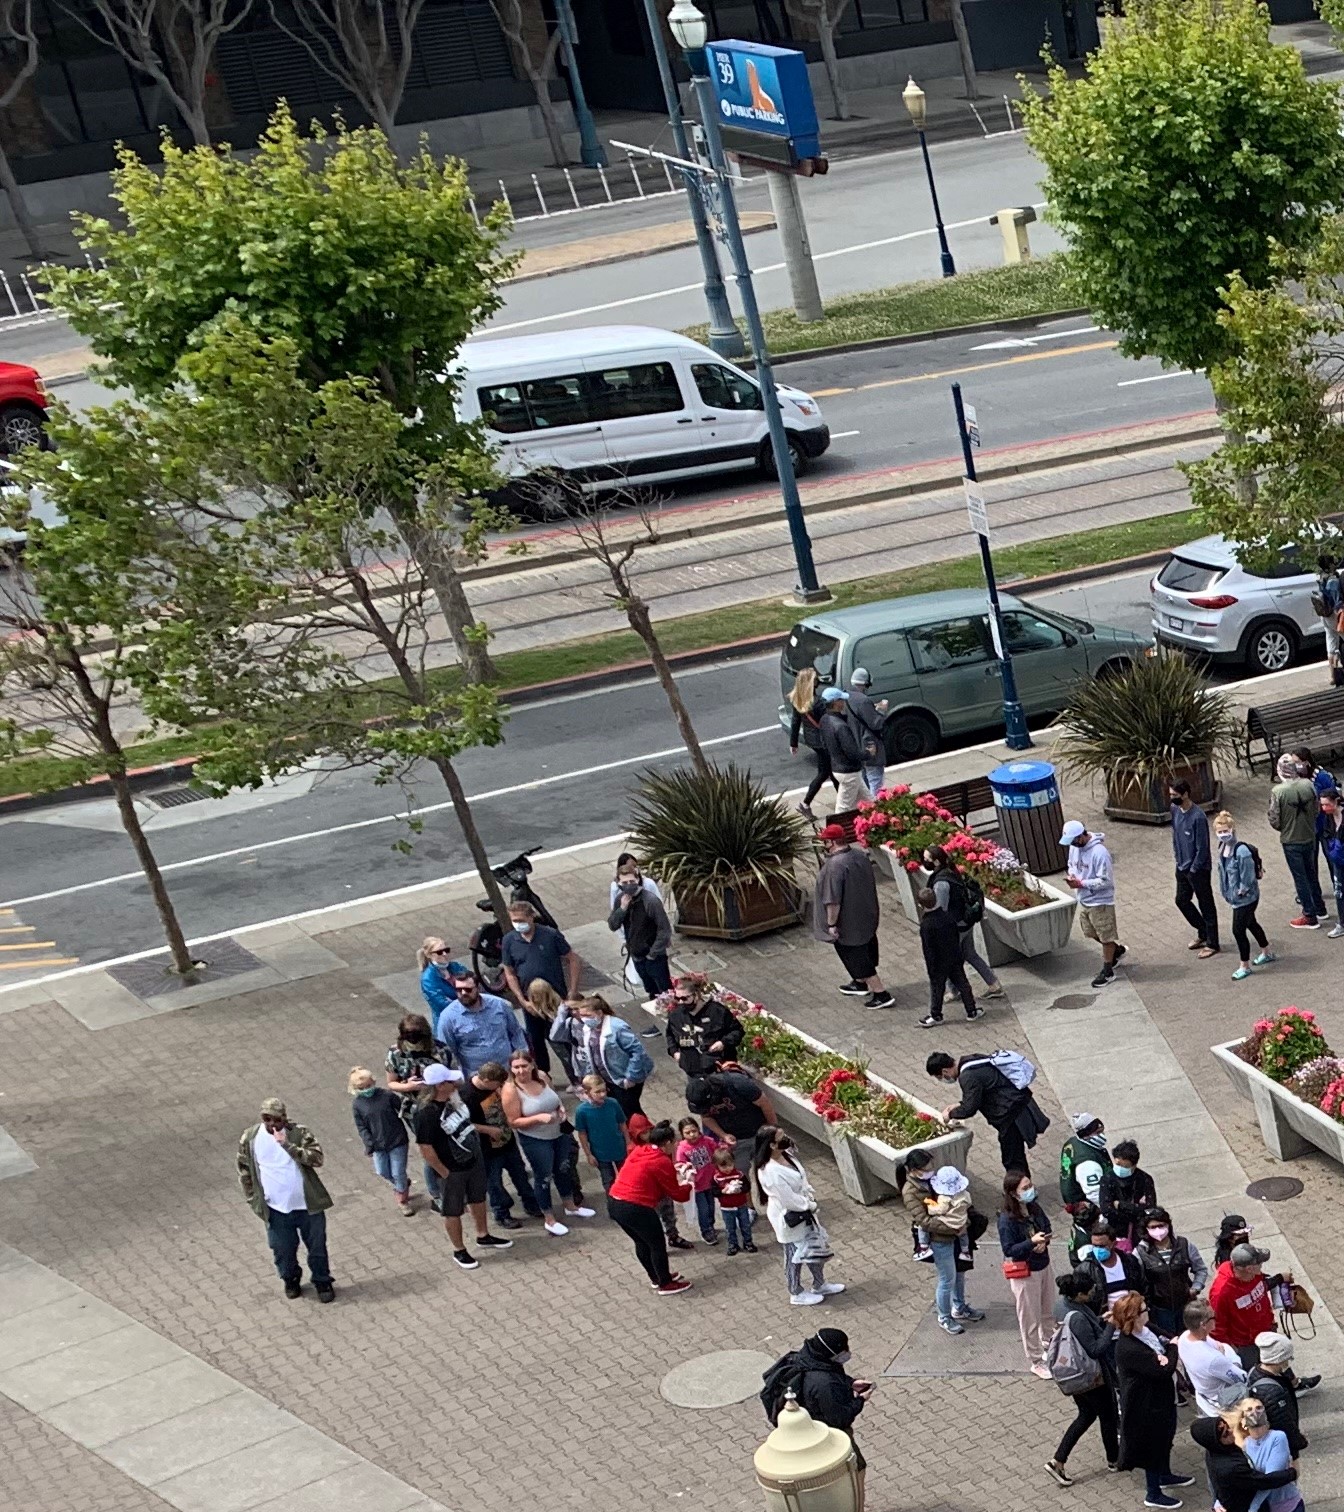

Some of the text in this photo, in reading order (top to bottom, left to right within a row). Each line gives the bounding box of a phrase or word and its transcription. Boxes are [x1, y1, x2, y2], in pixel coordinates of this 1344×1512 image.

[718, 63, 735, 84] 39
[731, 103, 785, 125] PUBLIC PARKING
